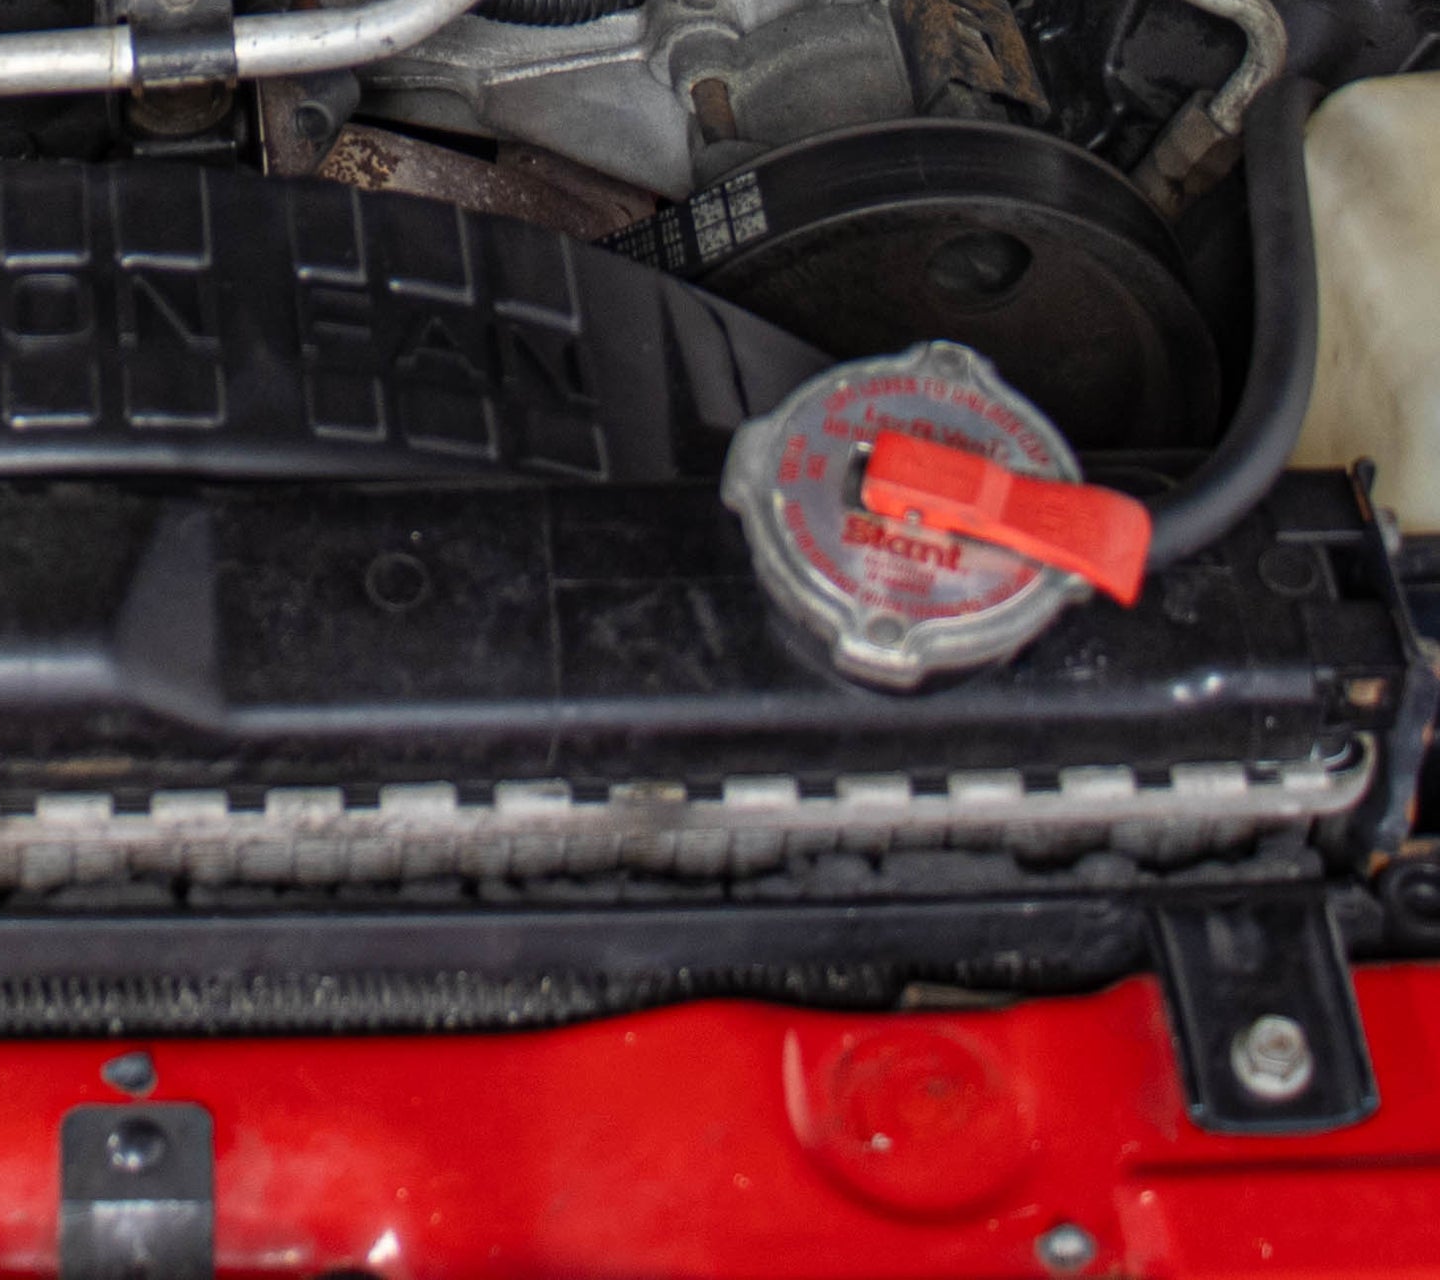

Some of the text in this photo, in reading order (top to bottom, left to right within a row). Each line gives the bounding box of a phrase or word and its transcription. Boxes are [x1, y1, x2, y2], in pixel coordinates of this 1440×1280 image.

[296, 285, 598, 408] FAN
[923, 378, 947, 399] TO
[842, 513, 964, 570] Stant
